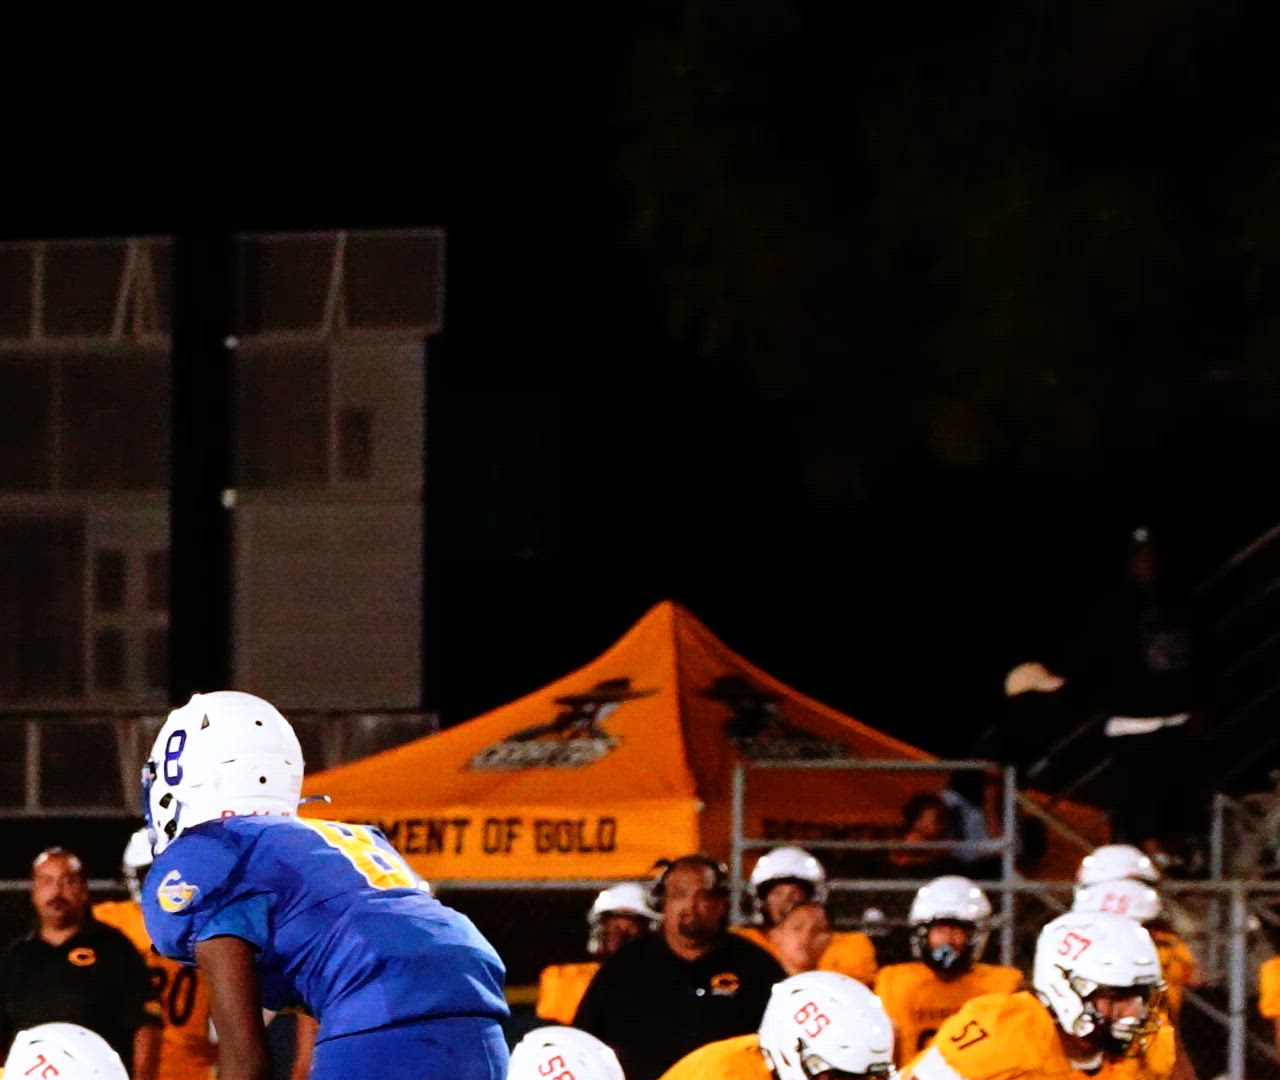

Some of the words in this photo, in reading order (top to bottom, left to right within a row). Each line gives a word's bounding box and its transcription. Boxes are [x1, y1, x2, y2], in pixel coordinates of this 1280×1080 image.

[163, 729, 187, 786] 8
[295, 818, 419, 890] 8
[483, 817, 523, 854] OF
[533, 817, 617, 854] GOLD
[1056, 931, 1093, 962] 57
[950, 1019, 989, 1052] 57
